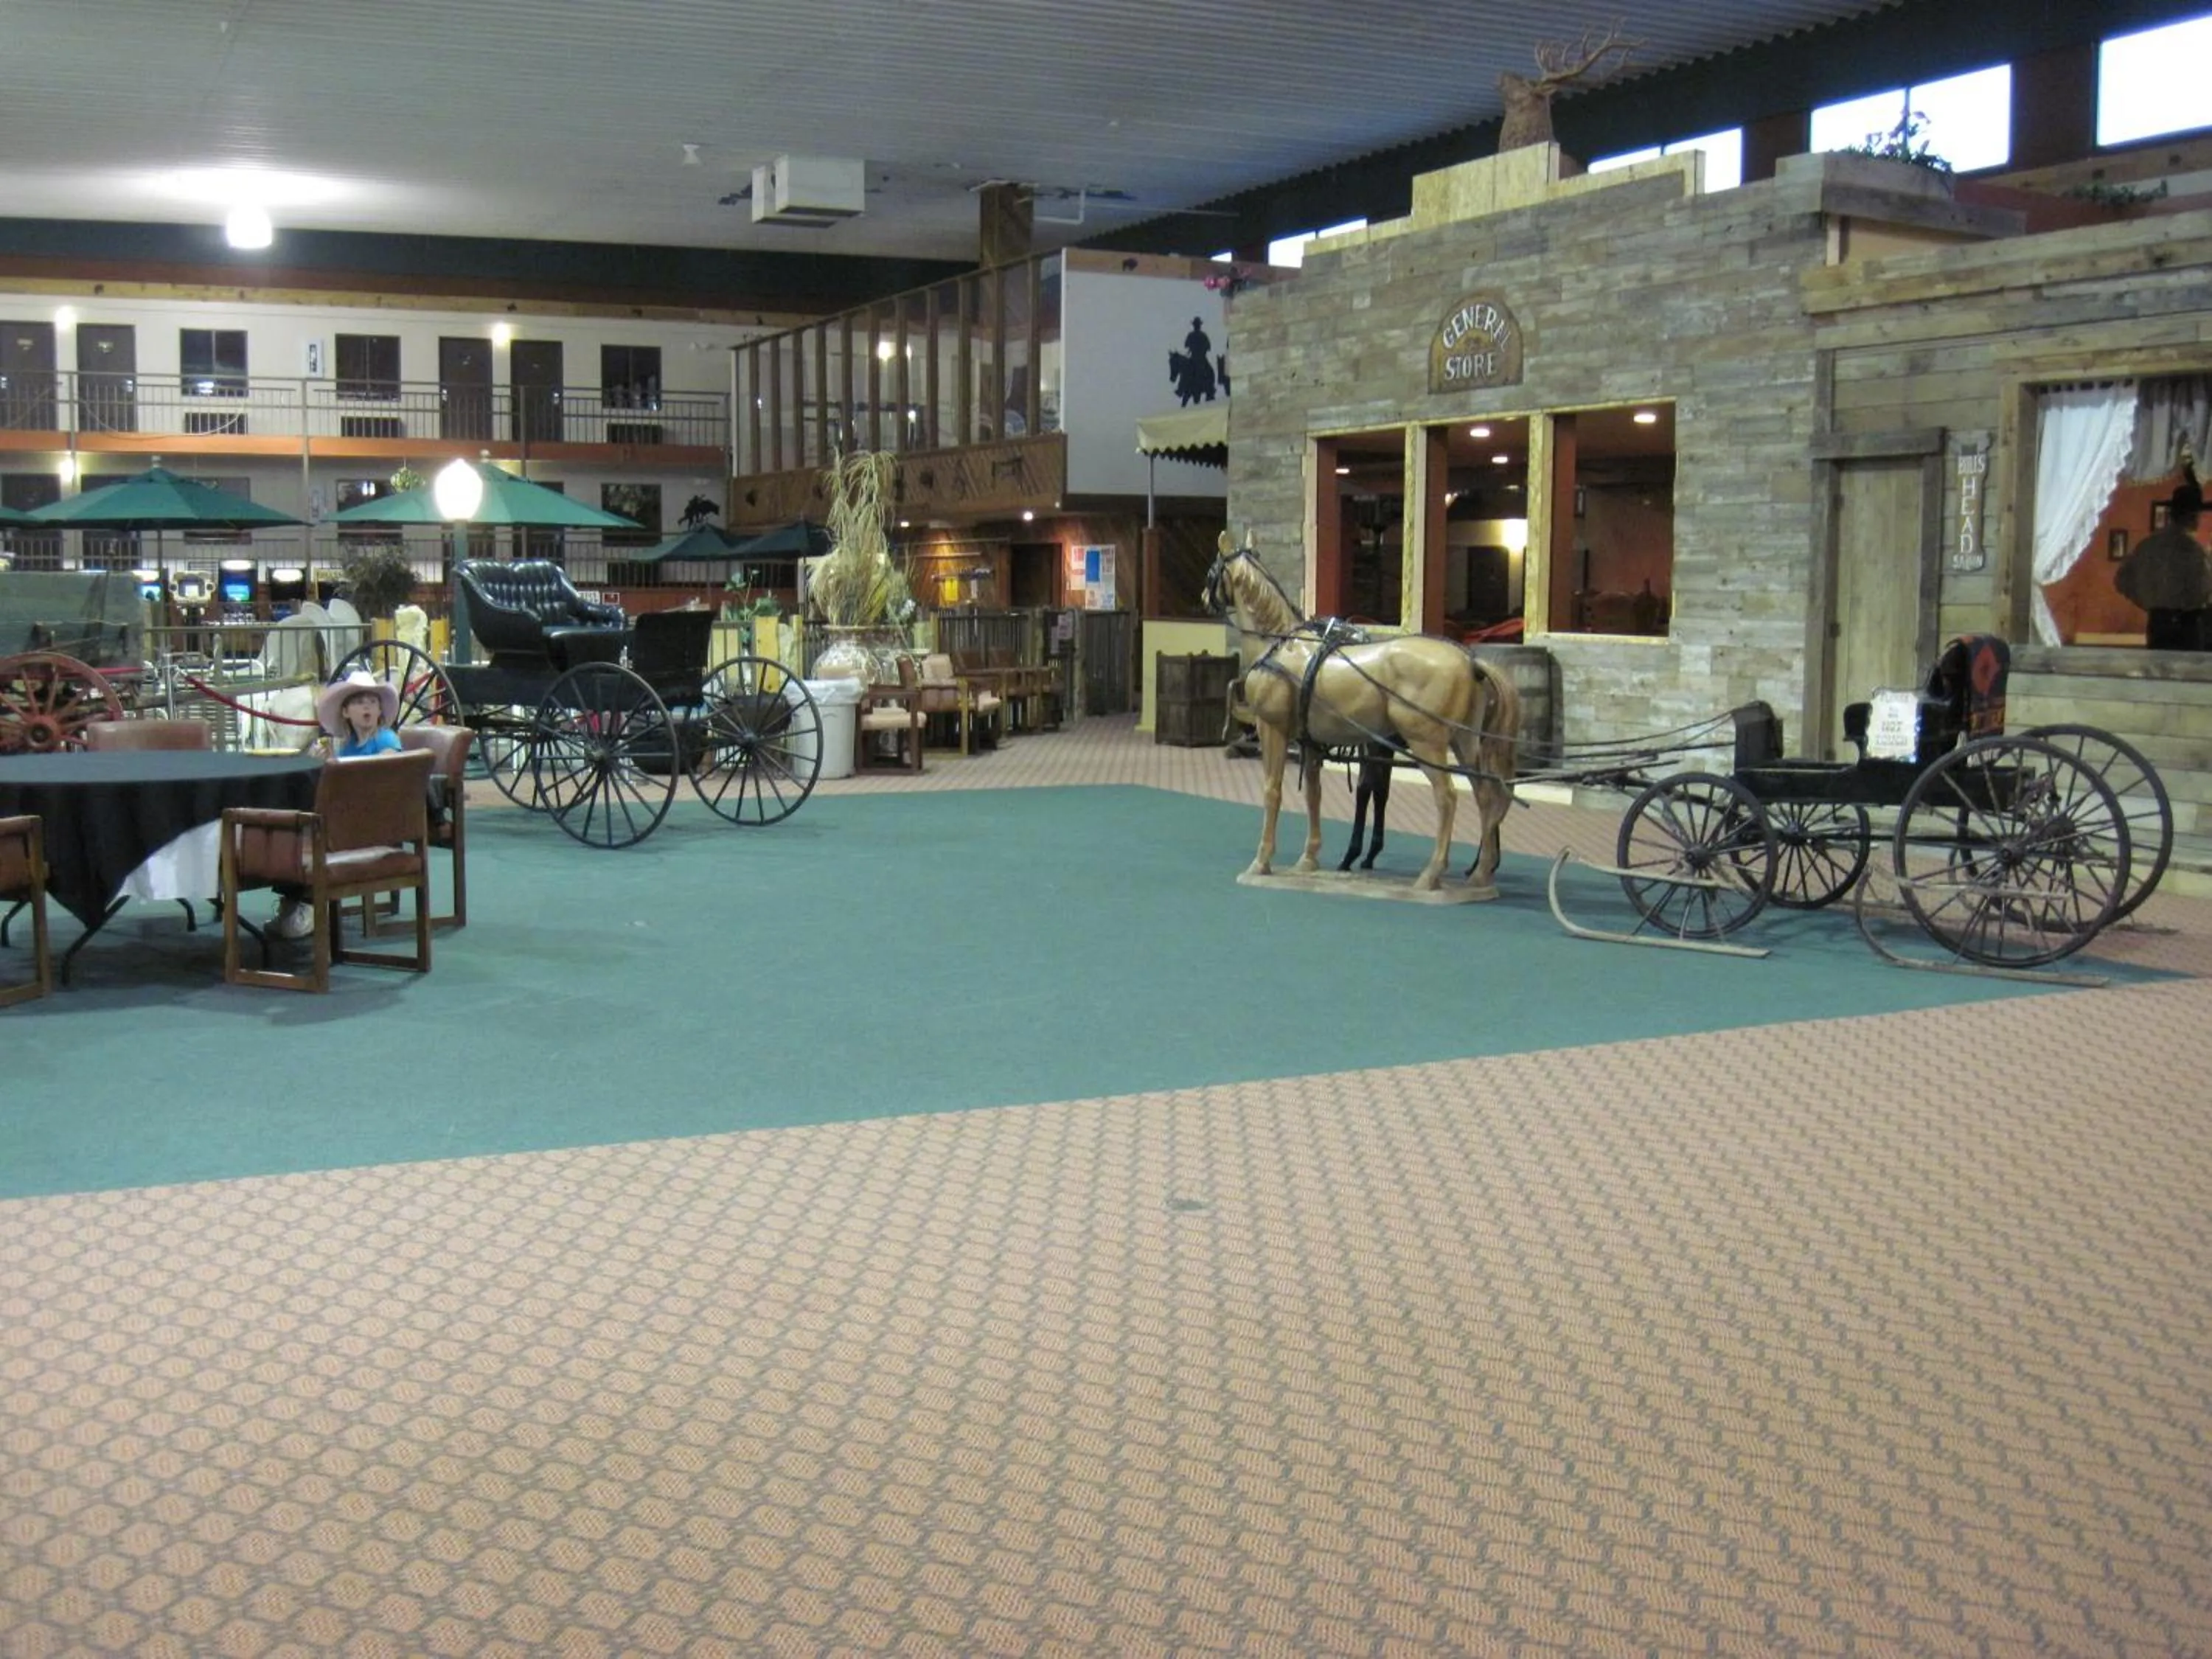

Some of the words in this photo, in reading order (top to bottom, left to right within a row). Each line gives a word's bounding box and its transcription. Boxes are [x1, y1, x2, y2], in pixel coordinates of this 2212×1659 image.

[1443, 304, 1511, 352] GENERAL
[1444, 352, 1497, 380] STORE
[1960, 476, 1976, 554] HEAD
